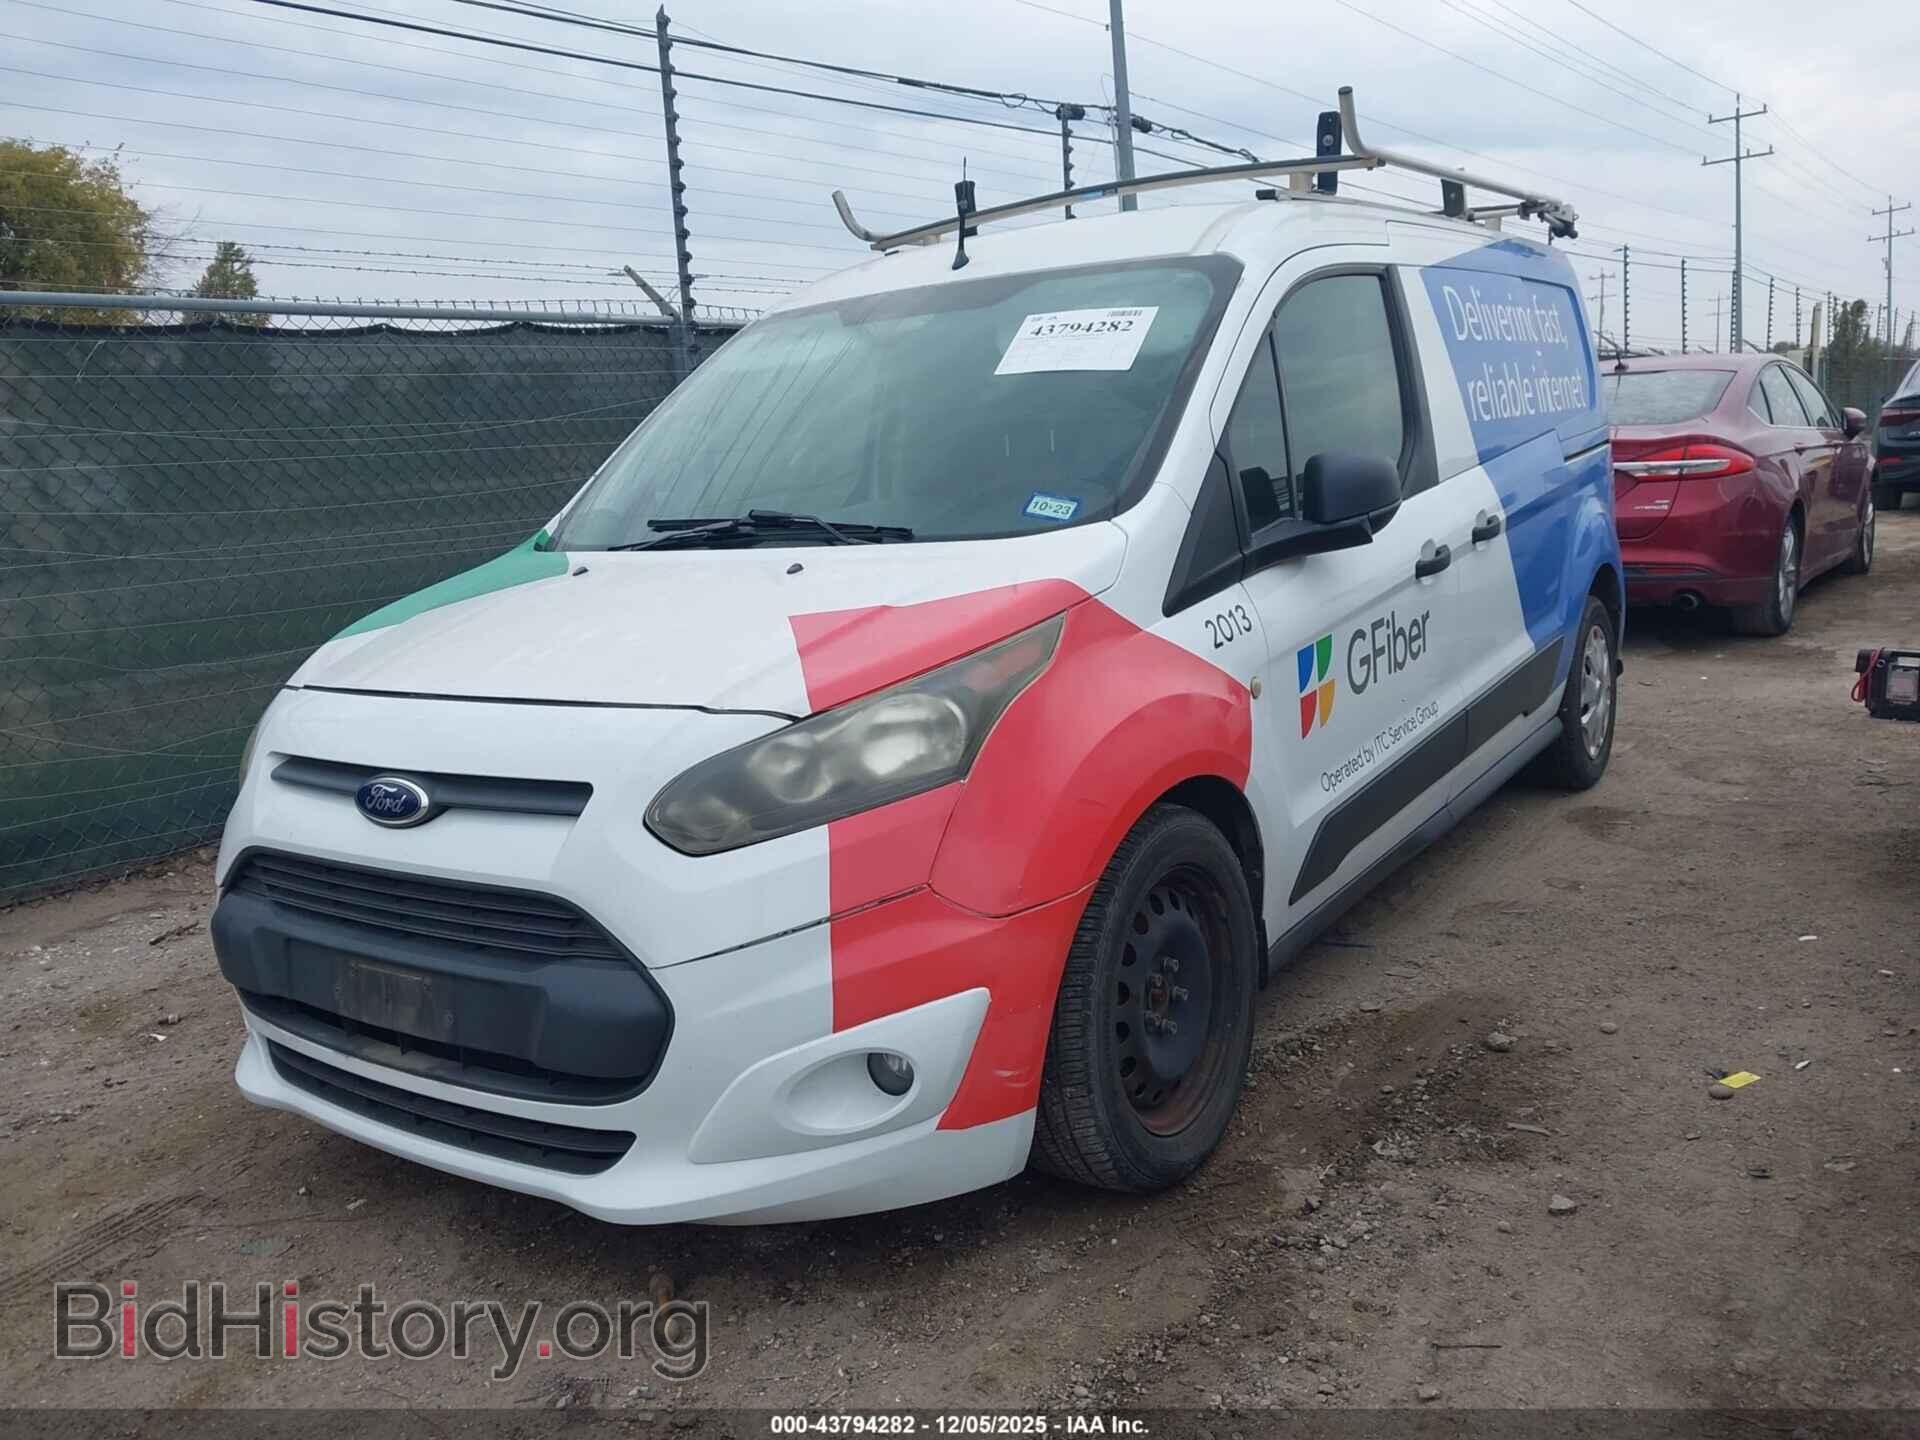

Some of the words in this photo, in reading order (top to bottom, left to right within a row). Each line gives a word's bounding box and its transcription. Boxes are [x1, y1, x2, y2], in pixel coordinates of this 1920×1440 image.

[1030, 320, 1133, 336] 43794282
[1467, 361, 1535, 422] reliable
[1204, 604, 1252, 650] 2013
[1347, 609, 1430, 695] GFiber
[1320, 748, 1365, 792] Operated
[1361, 744, 1376, 764] by
[1374, 730, 1390, 753] ITC
[1388, 716, 1418, 745] Service
[1415, 700, 1439, 725] Group
[365, 784, 407, 812] Ford
